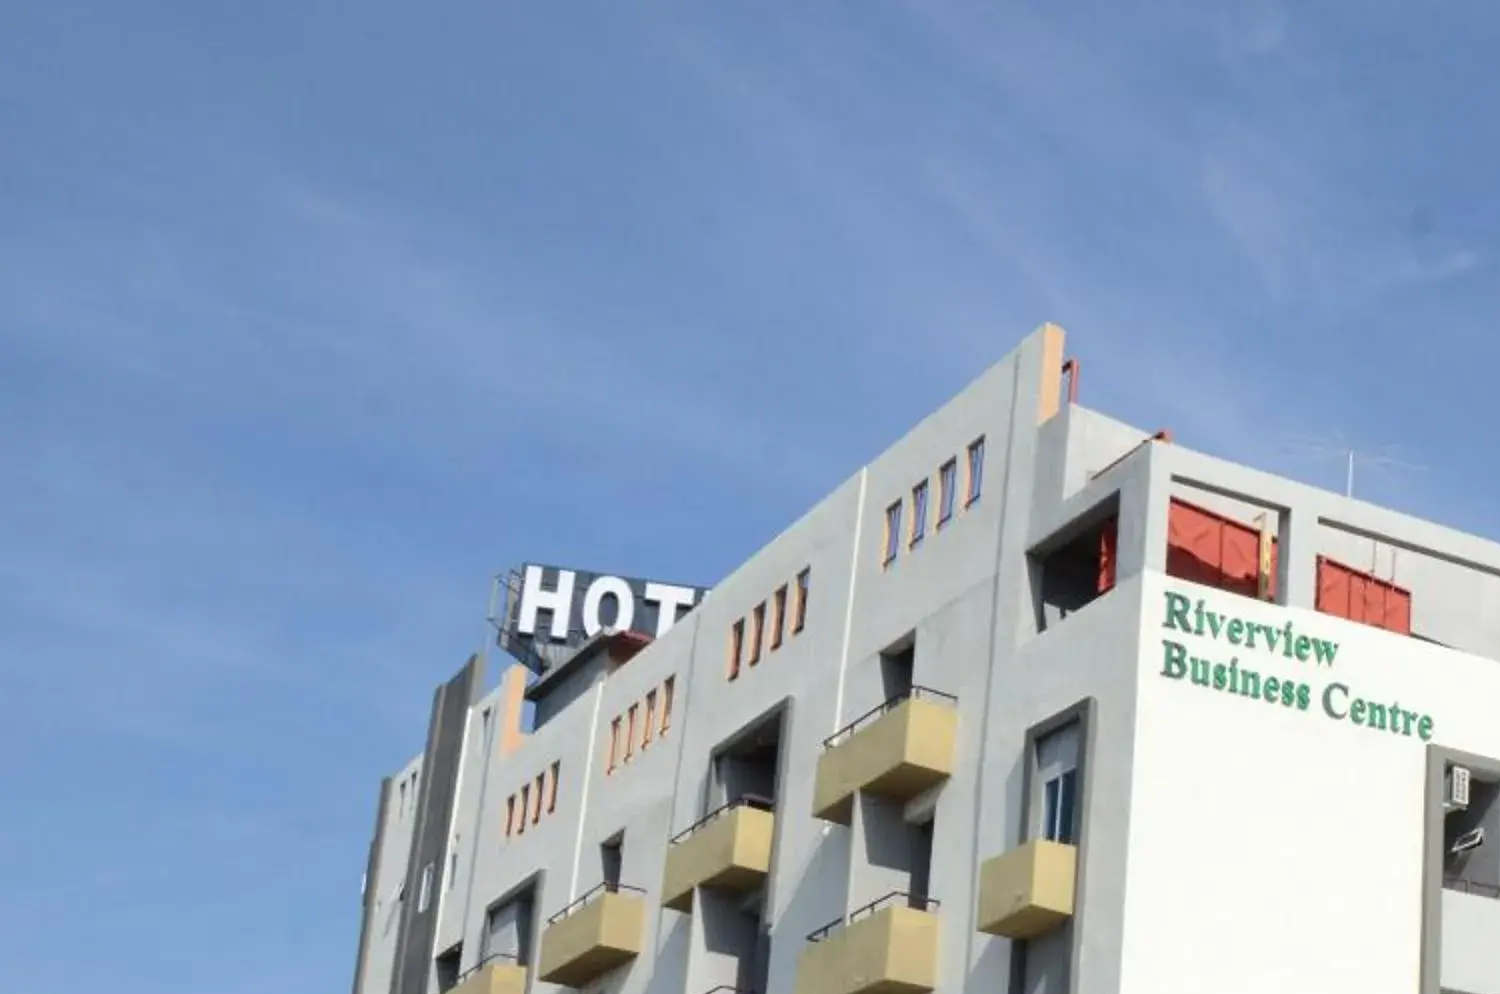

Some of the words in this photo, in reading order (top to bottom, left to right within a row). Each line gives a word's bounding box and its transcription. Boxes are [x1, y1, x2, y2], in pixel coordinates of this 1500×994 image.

[517, 565, 712, 639] HOT
[1161, 590, 1340, 667] Riverview
[1160, 639, 1311, 711] Business
[1321, 681, 1435, 741] Centre
